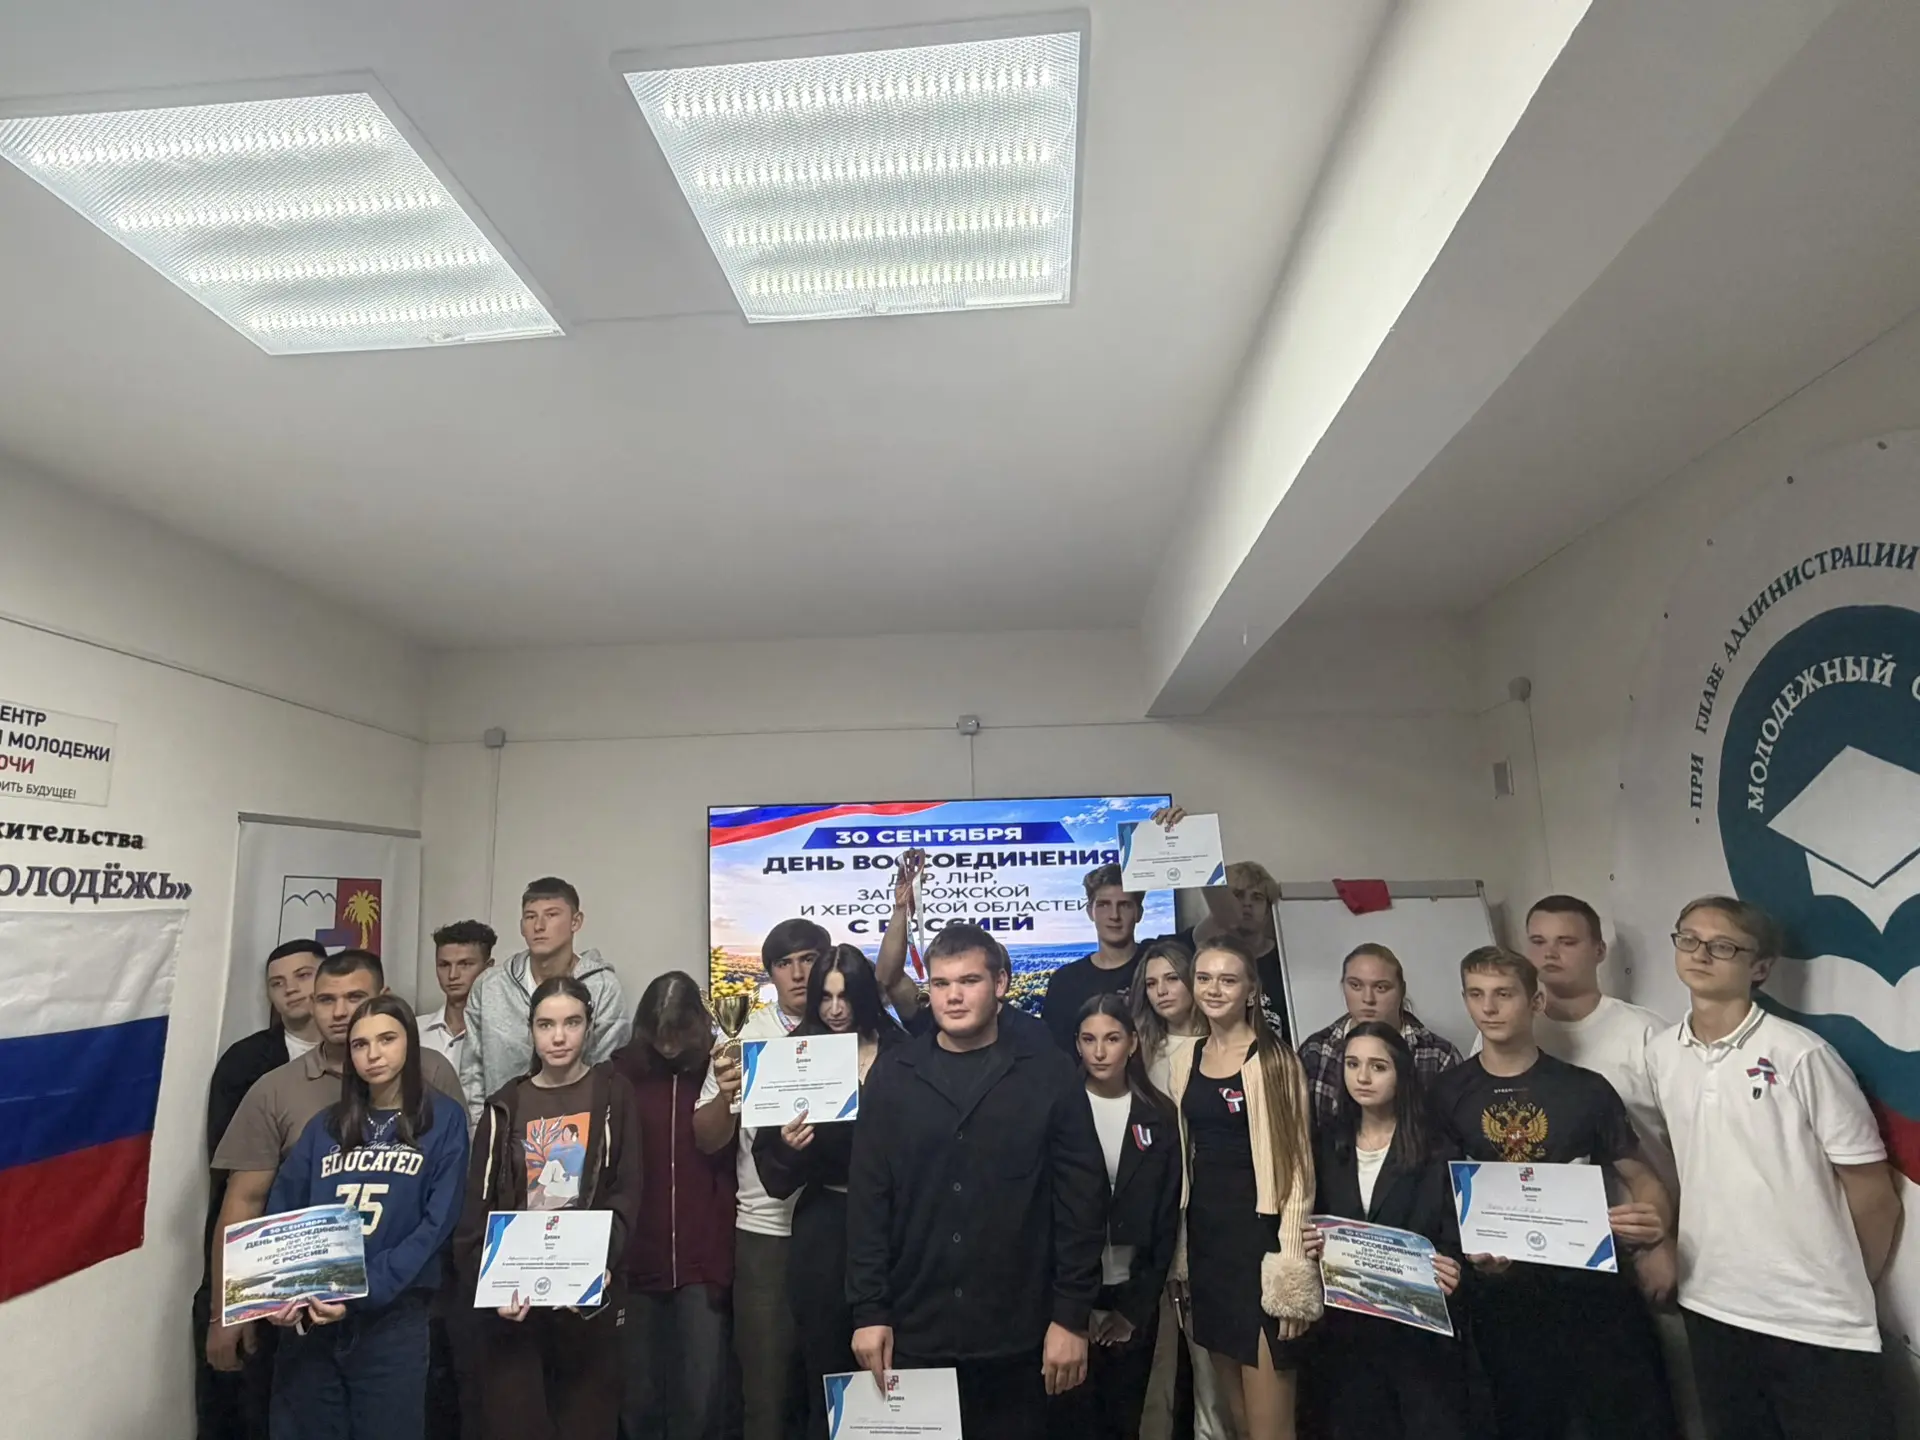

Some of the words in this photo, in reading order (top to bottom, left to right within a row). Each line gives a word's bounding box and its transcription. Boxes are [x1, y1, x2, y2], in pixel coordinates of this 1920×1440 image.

[1723, 542, 1920, 662] АДМИНИСТРАЦИИ
[1695, 662, 1725, 734] ГЛАВЕ
[1748, 652, 1897, 813] МОЛОДЕЖНЫЙ
[8, 731, 111, 762] МОЛОДЕЖИ
[0, 780, 23, 793] ИТЬ
[26, 783, 77, 799] БУДУЩЕЕ!
[1690, 752, 1704, 809] ПРИ
[835, 830, 870, 844] 30
[876, 827, 1023, 843] СЕНТЯБРЯ
[763, 856, 845, 874] ДЕНЬ
[946, 871, 998, 885] ЛНР,
[857, 884, 1030, 901] ЗАПРОЖСКОЙ
[801, 904, 815, 916] И
[821, 901, 968, 916] ХЕРСОКОЙ
[848, 919, 869, 934] С
[320, 1150, 424, 1178] EDUCATED
[245, 1238, 273, 1250] ДЕНЬ
